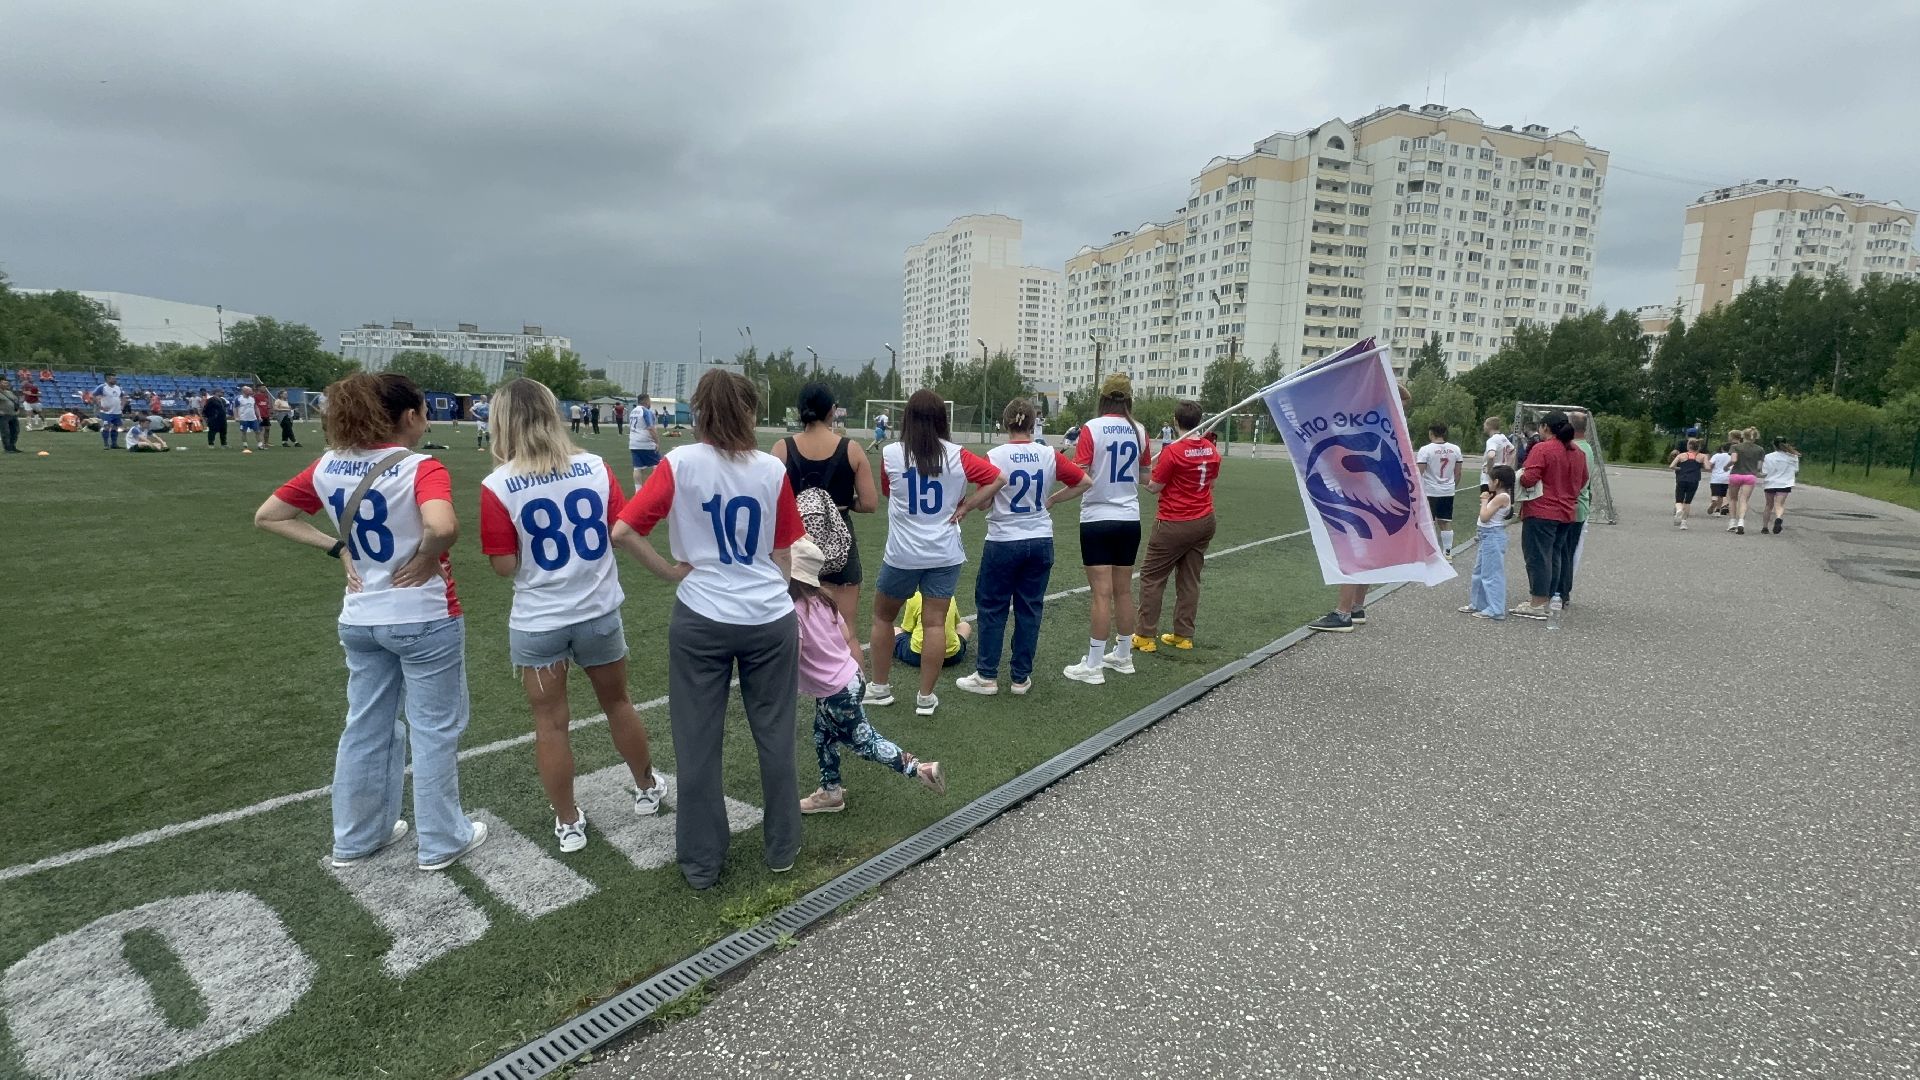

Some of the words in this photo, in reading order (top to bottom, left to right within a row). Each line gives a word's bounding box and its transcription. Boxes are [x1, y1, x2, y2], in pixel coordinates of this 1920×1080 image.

[1295, 416, 1328, 443] НПО
[1106, 440, 1138, 483] 12
[1439, 457, 1449, 478] 7
[902, 467, 943, 515] 15
[1009, 469, 1044, 513] 21
[328, 488, 395, 563] 18
[521, 488, 608, 571] 88
[702, 494, 762, 565] 10
